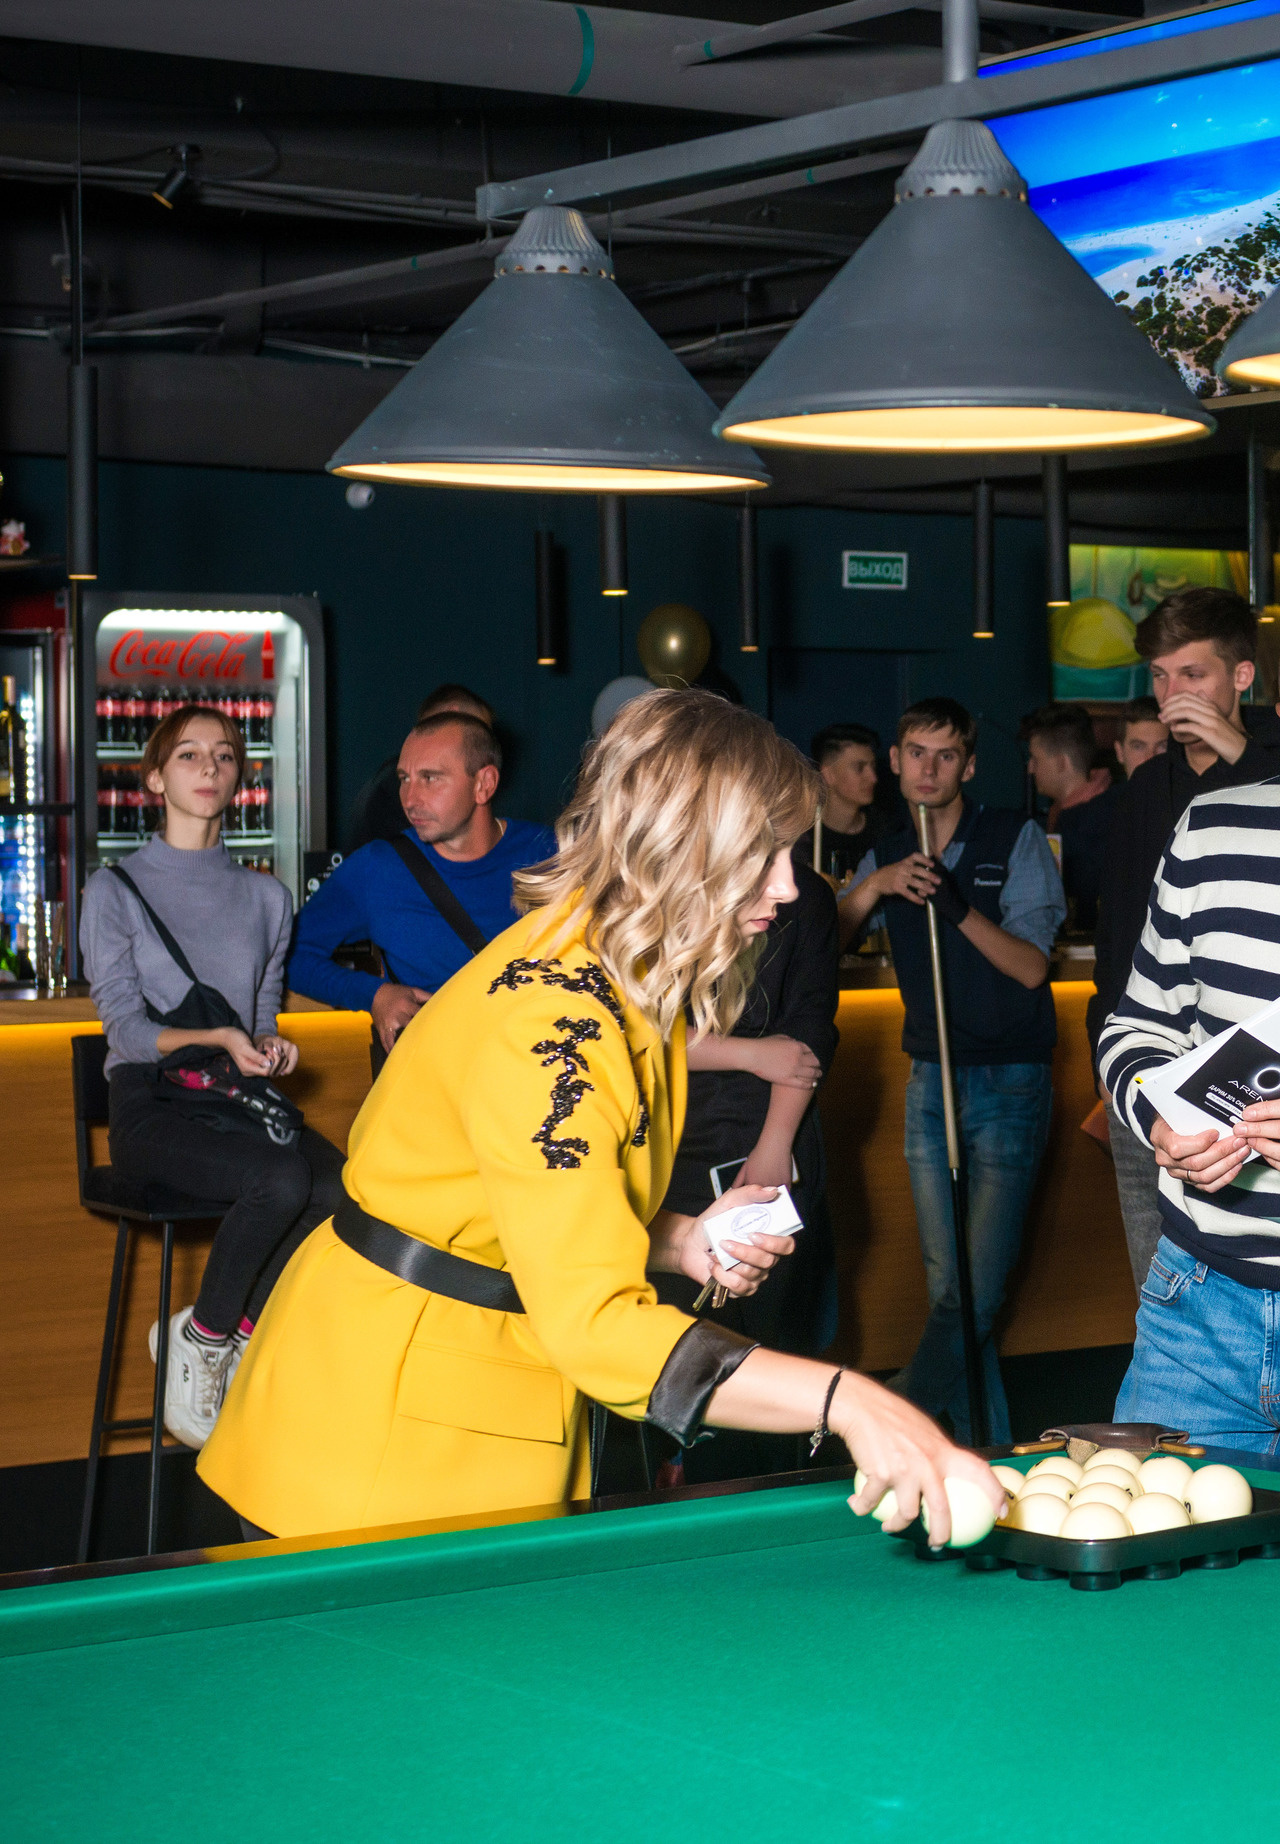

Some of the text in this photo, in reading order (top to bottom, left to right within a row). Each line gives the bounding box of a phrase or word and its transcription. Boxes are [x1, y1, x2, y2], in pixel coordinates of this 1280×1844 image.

[848, 561, 903, 582] ВЫХОД
[109, 629, 253, 678] Coca-Cola
[1227, 1080, 1268, 1103] AREN
